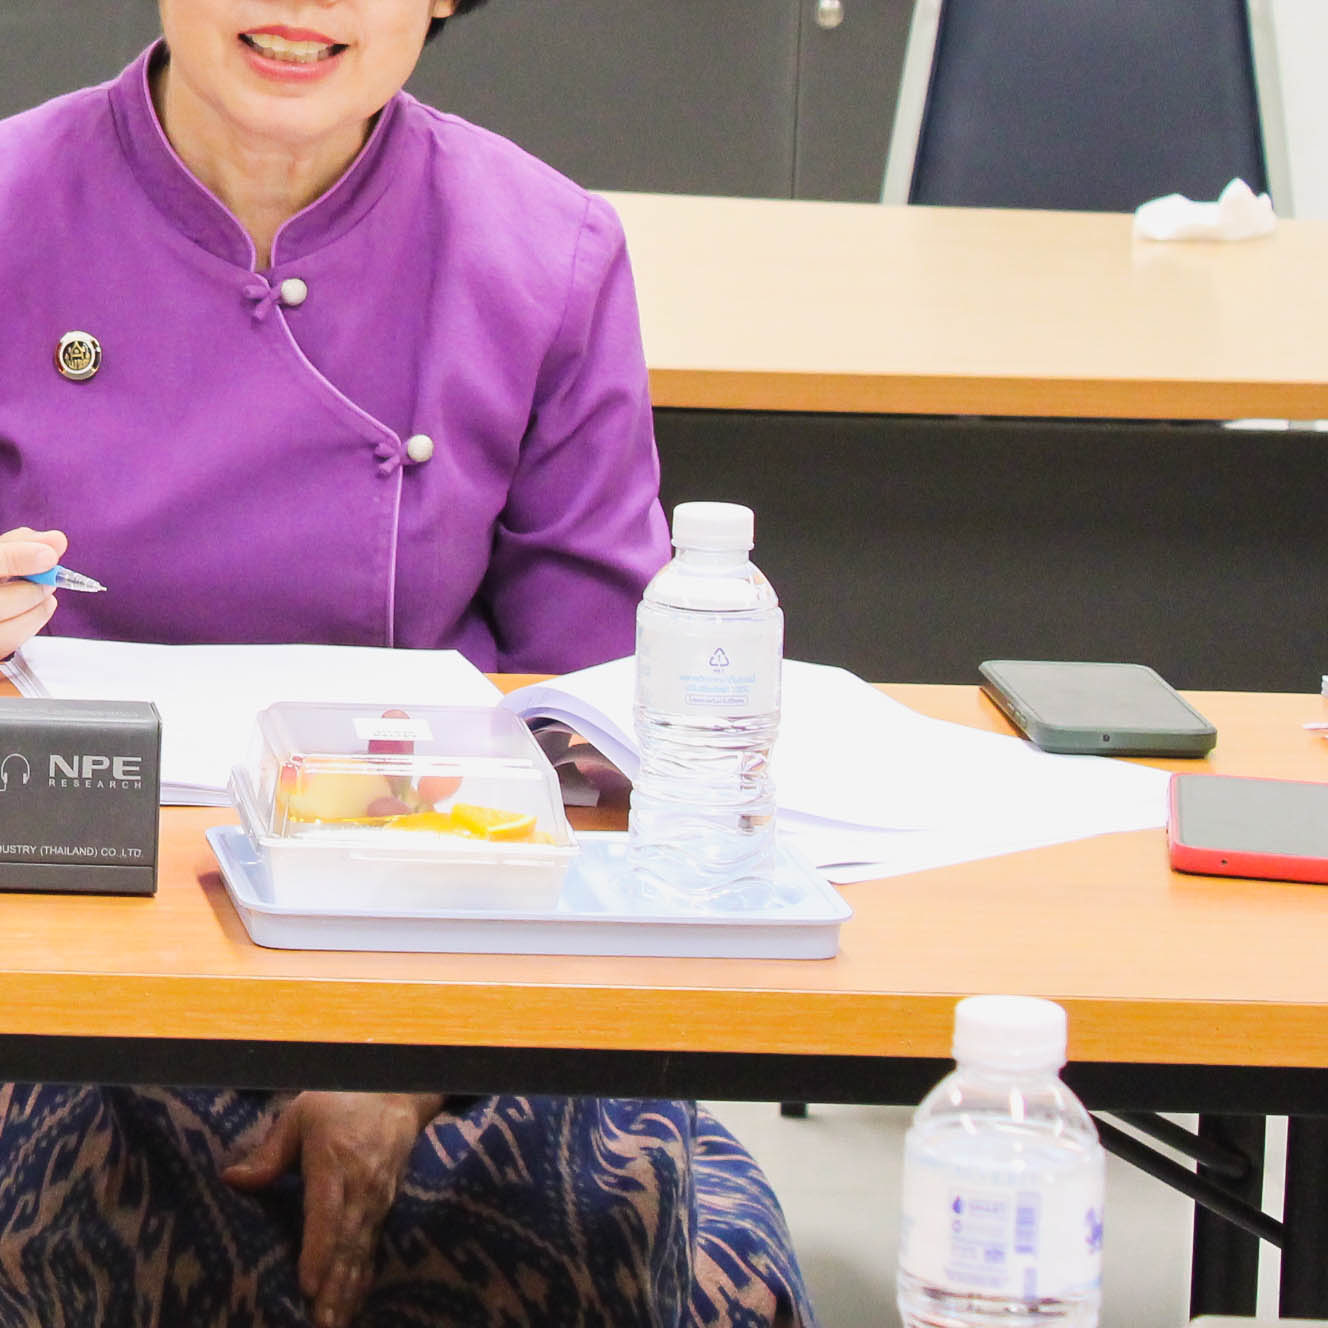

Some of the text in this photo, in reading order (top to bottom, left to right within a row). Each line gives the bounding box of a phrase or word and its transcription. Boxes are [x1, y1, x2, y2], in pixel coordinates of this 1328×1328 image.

[48, 754, 142, 780] NPE
[48, 779, 142, 790] RESEARCH
[40, 845, 98, 857] (THAILAND)
